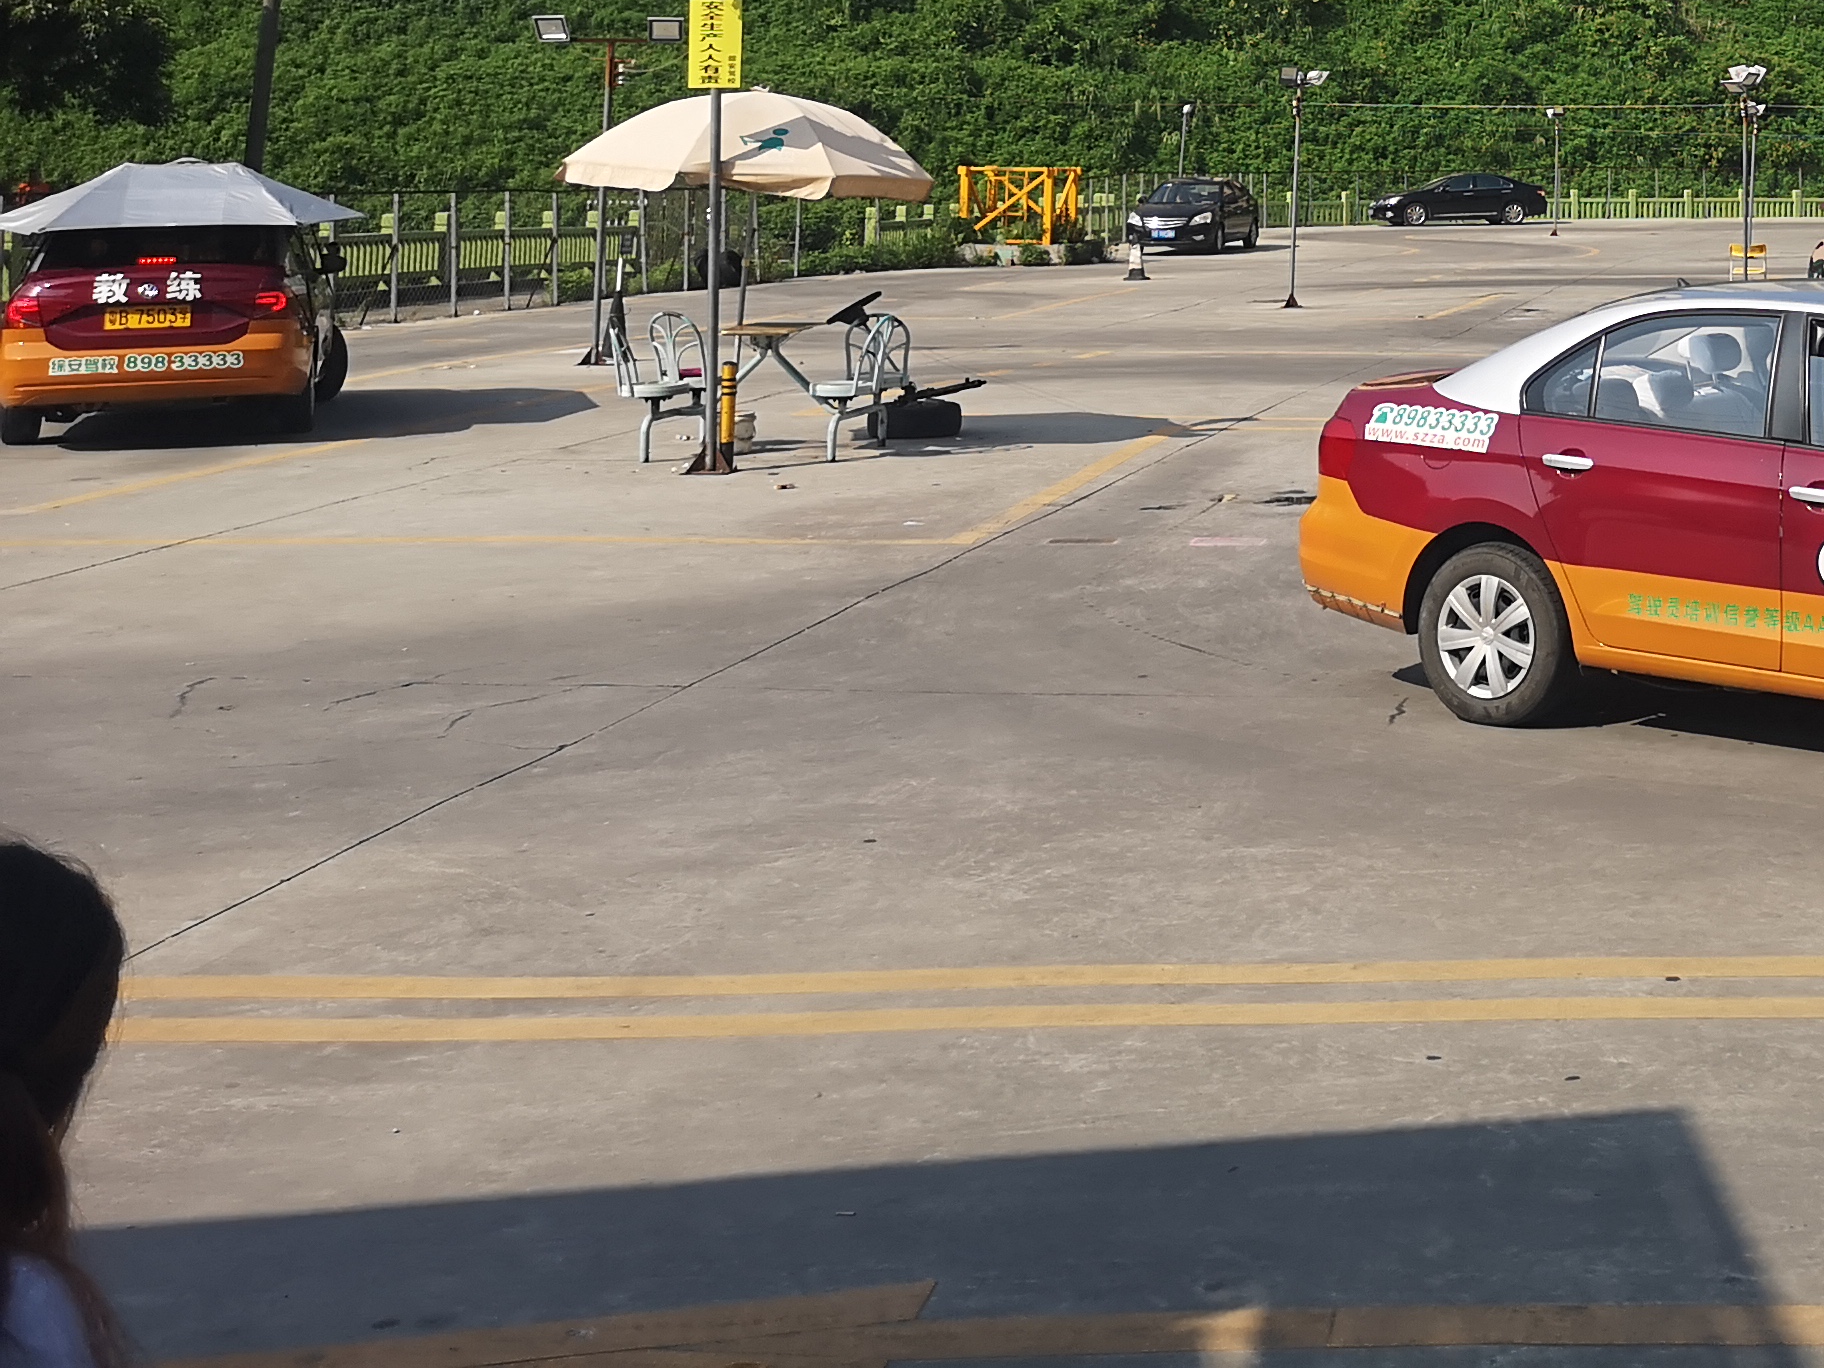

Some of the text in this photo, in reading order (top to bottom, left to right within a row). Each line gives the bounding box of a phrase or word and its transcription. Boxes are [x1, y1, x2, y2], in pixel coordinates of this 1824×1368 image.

[700, 1, 724, 84] 安全生产人人有责
[1392, 407, 1495, 436] 89833333
